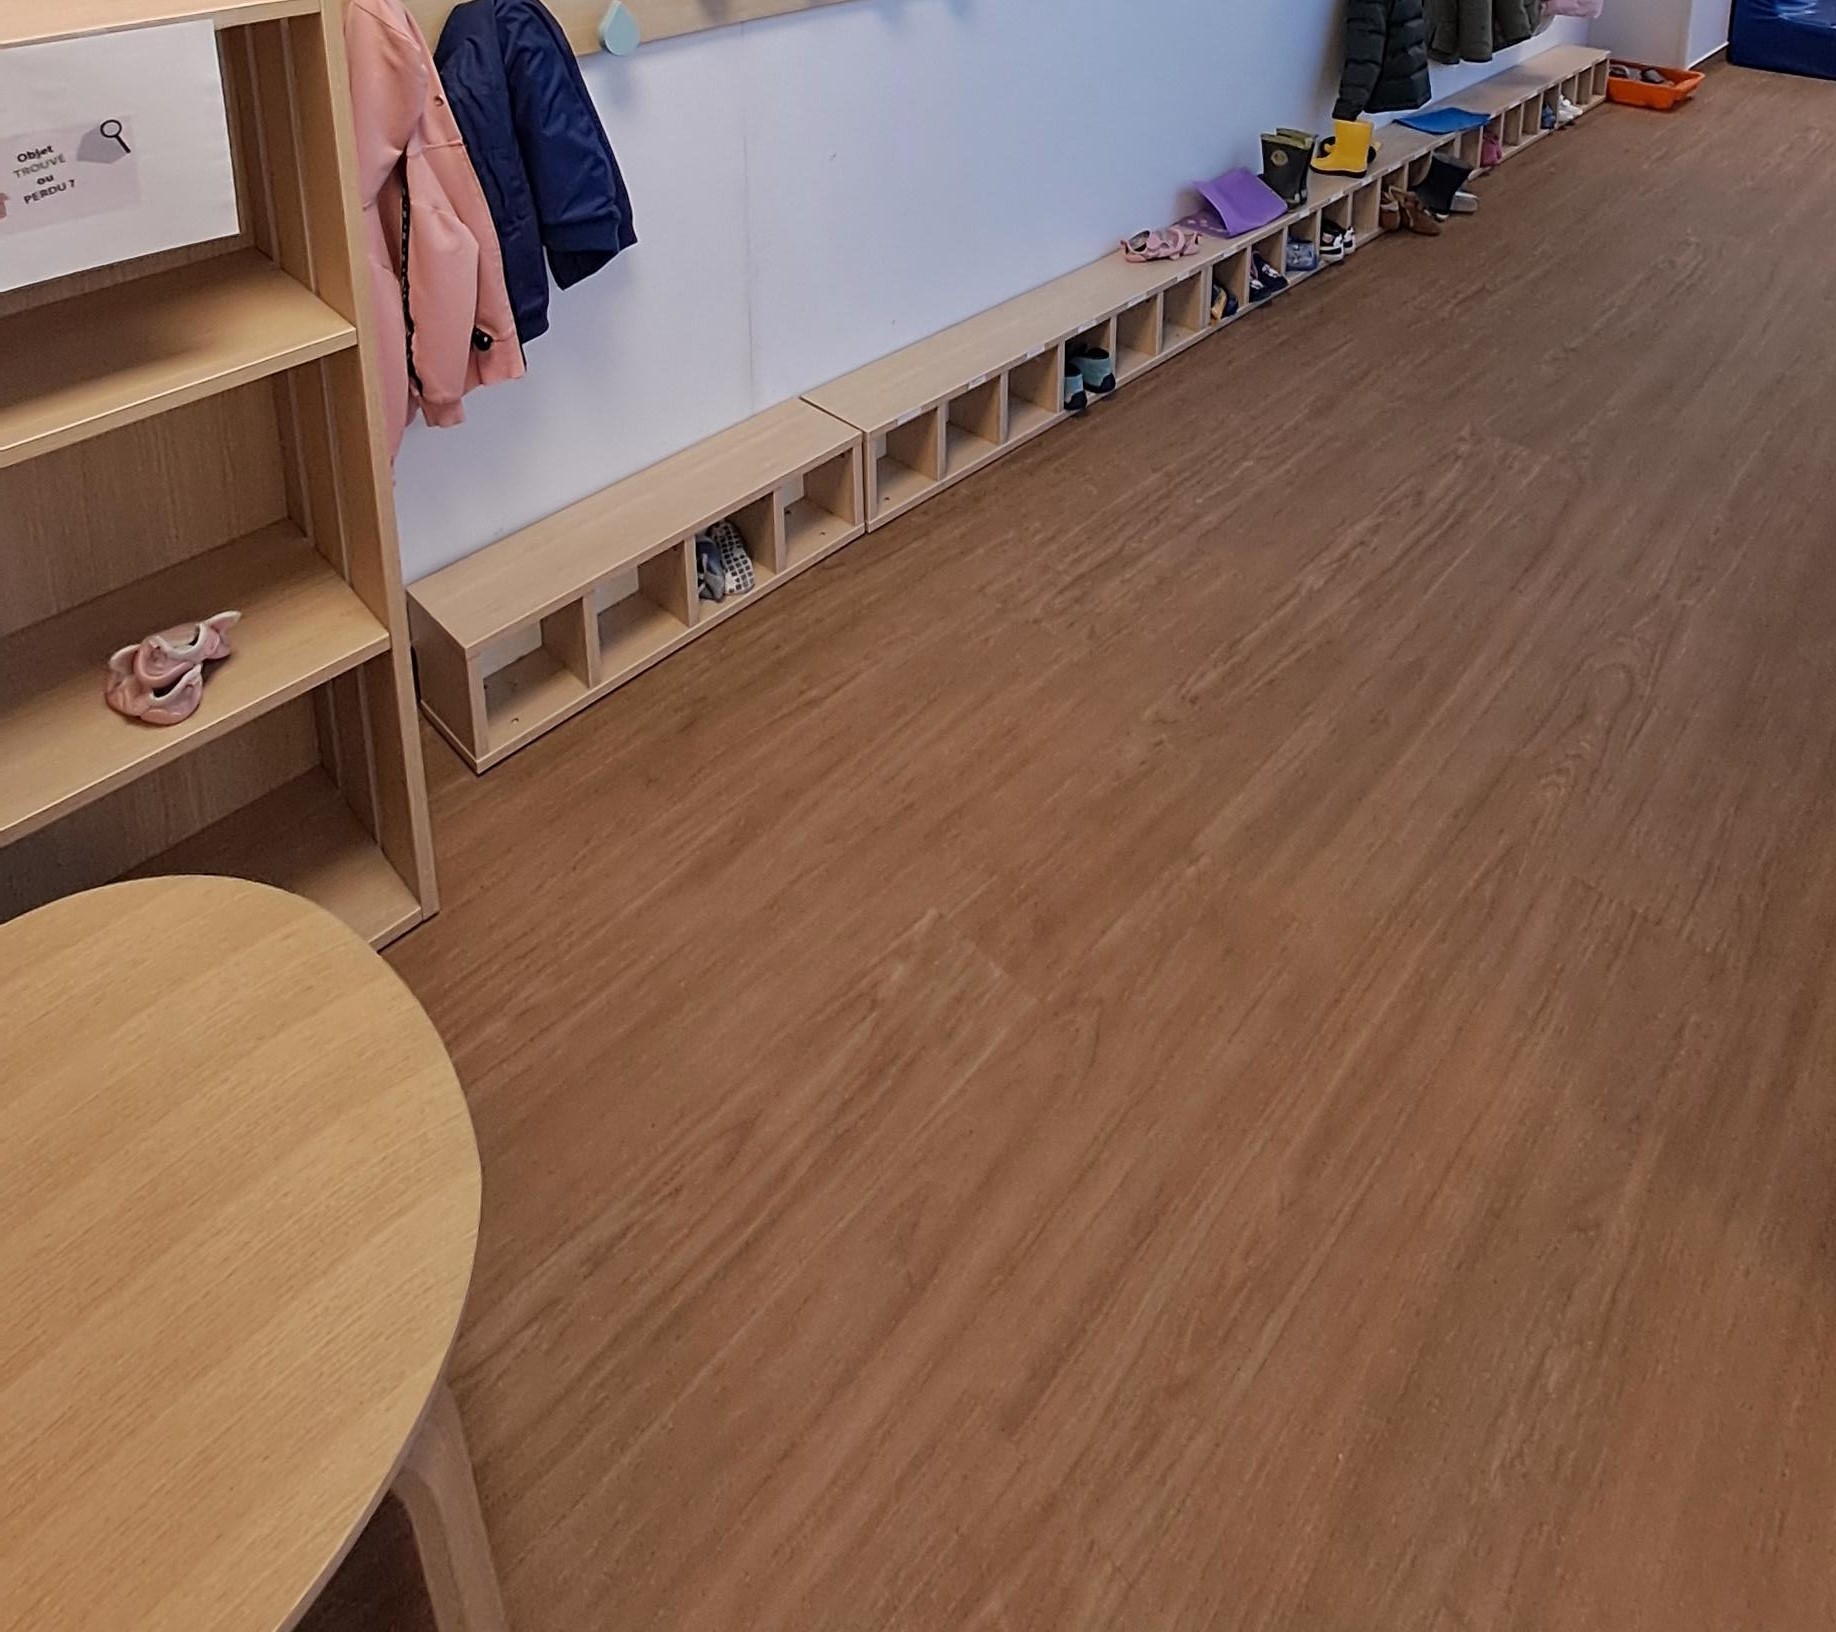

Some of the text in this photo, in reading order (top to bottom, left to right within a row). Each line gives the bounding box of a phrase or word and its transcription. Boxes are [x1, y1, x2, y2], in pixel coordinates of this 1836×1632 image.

[17, 145, 54, 163] Objet
[37, 174, 54, 185] ou
[24, 182, 67, 204] PERDU
